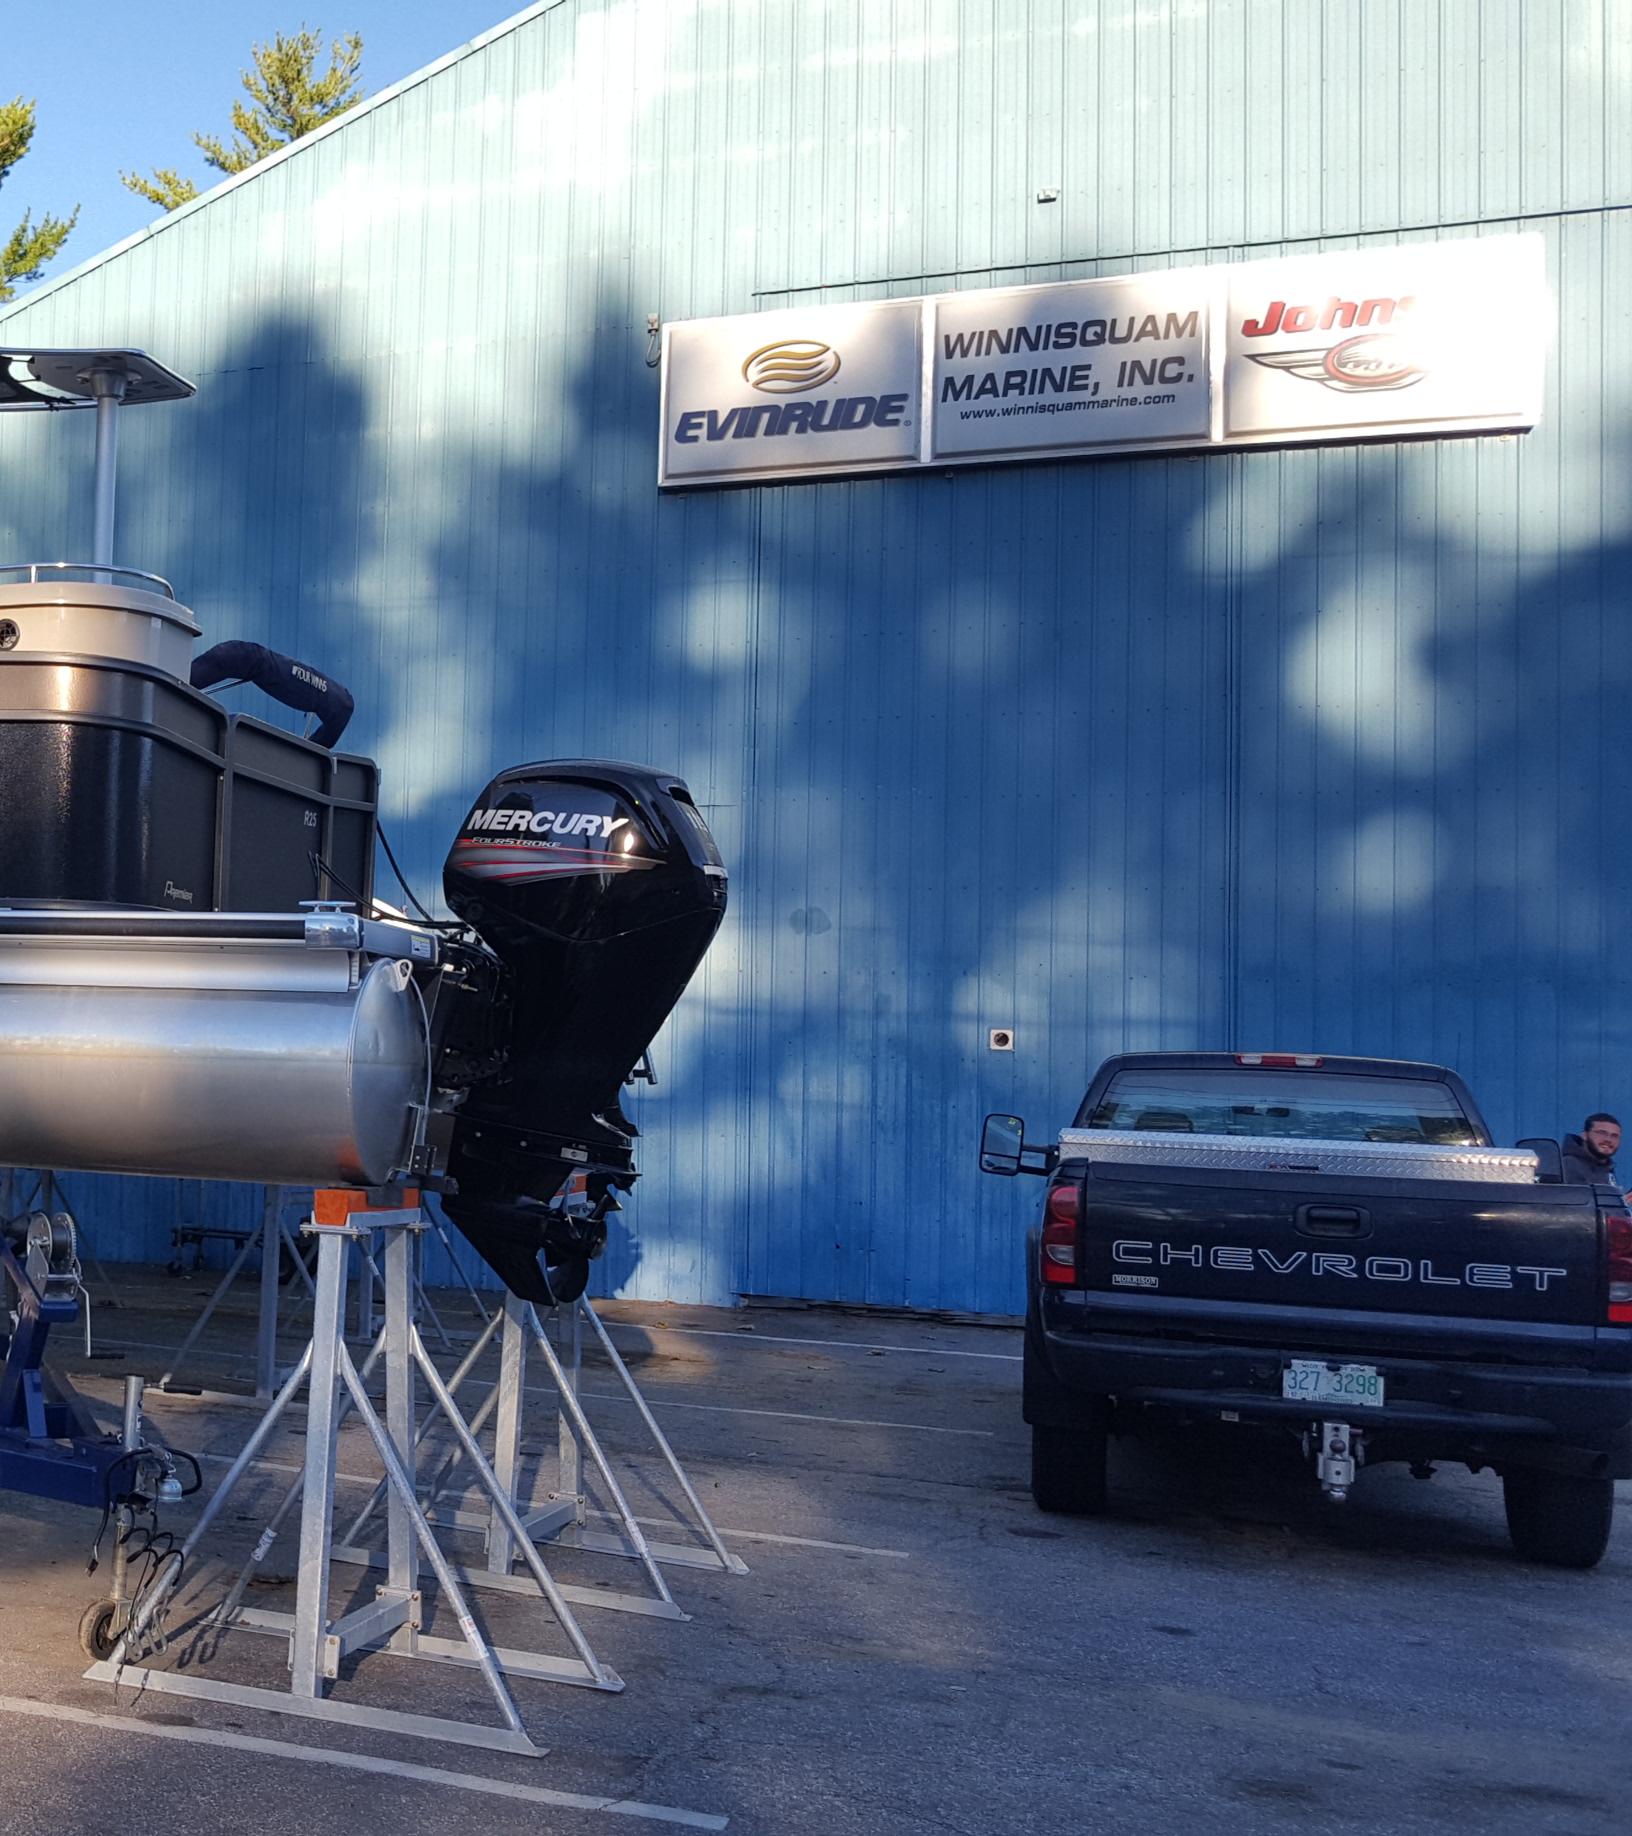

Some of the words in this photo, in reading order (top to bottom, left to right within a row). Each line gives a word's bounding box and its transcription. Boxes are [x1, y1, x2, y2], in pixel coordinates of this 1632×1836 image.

[943, 310, 1199, 360] WINNISQUAM
[940, 363, 1101, 403] MARINE,
[1116, 356, 1195, 388] INC.
[674, 393, 909, 444] EVINRUDE
[959, 393, 1176, 420] www.winnisquammarine.com
[303, 810, 317, 827] R25
[466, 808, 630, 838] MERCURY
[471, 836, 562, 848] FOURSTROKE
[1112, 1239, 1567, 1291] CHEVROLET
[1287, 1369, 1321, 1391] 327
[1332, 1372, 1378, 1396] 3298
